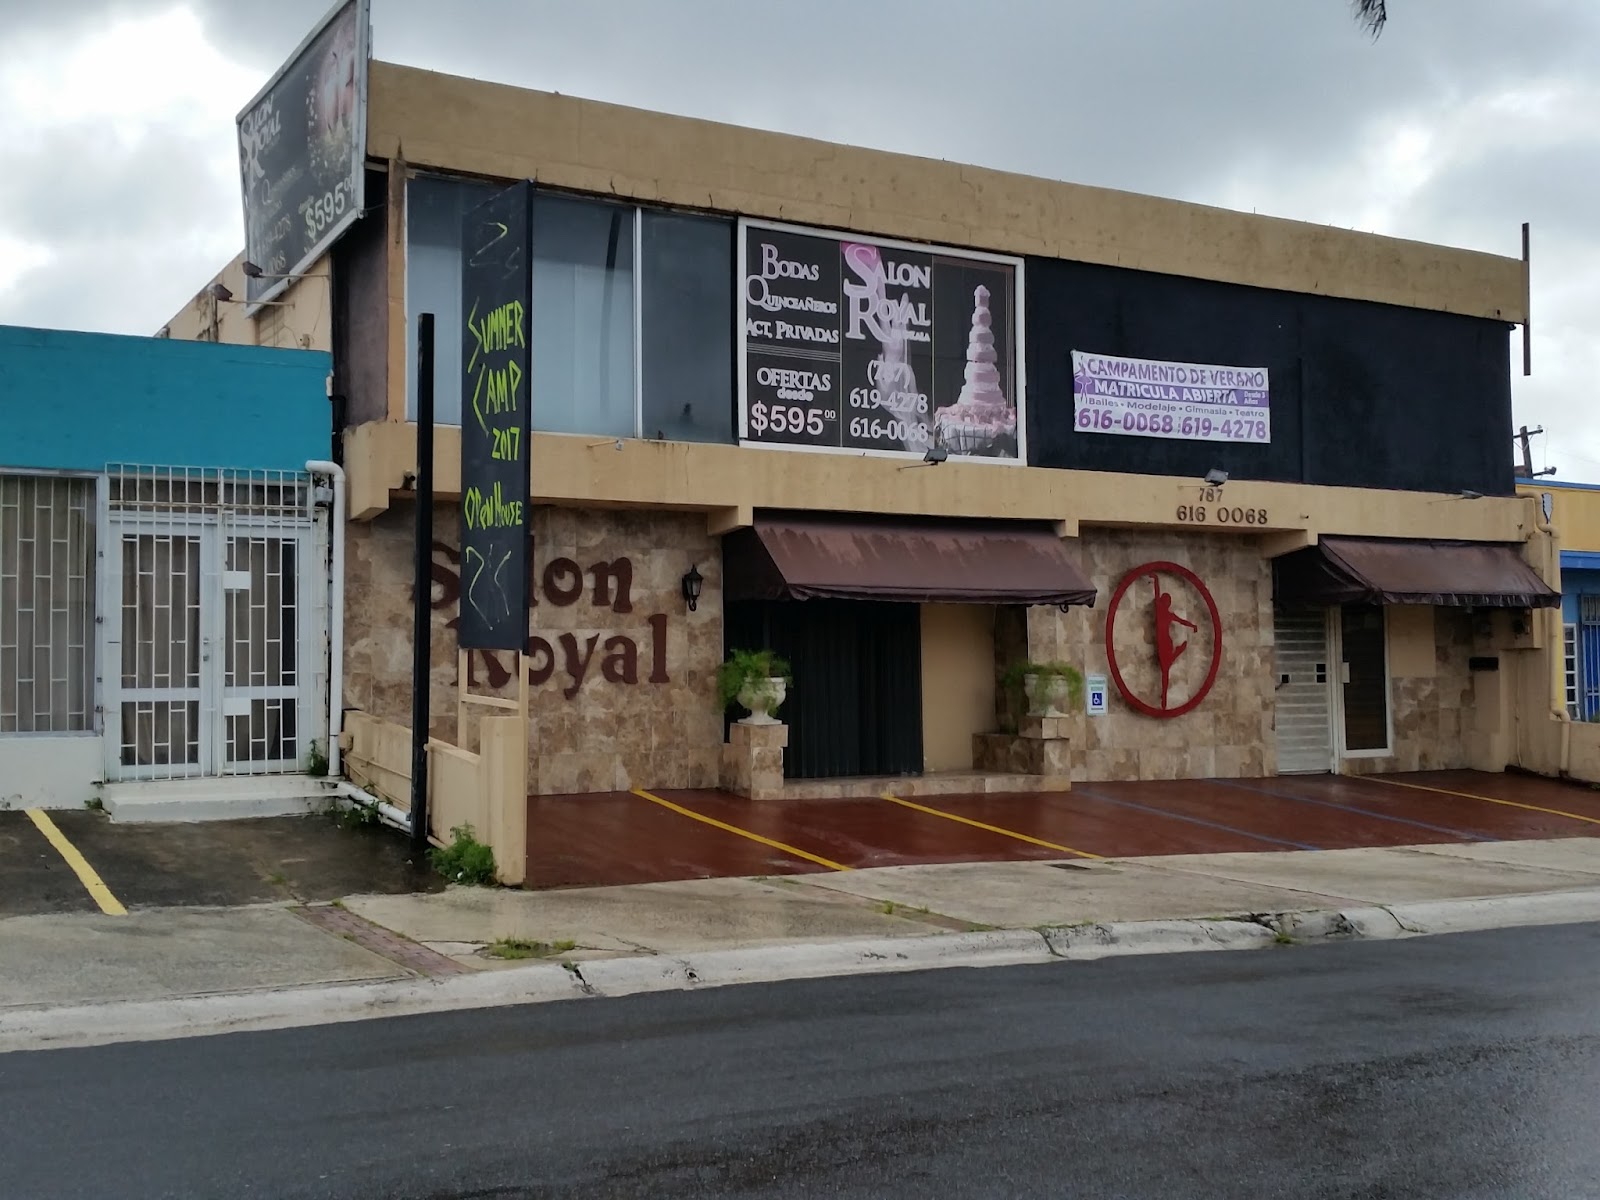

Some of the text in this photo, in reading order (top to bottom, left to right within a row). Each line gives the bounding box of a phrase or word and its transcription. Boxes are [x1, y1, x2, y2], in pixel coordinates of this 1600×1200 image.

[844, 243, 931, 298] SALON
[775, 321, 839, 343] PRIVADAS
[845, 294, 931, 343] ROYAL
[468, 298, 525, 374] SUMMER
[756, 367, 832, 392] OFERTAS
[867, 359, 911, 391] (77)
[1087, 359, 1265, 388] CAMPAMENTO DE VERANO
[472, 360, 522, 438] CAMP
[850, 387, 928, 414] 619-4278
[1094, 379, 1239, 405] MATRICULA ABIERTA
[1089, 397, 1266, 418] Bailes Modelaje Gimnasia Teatro
[850, 417, 928, 441] 616-0068
[1078, 407, 1174, 435] 616-0068
[1181, 416, 1267, 440] 619-4278
[491, 427, 521, 462] 2017
[1199, 487, 1224, 503] 787
[1176, 505, 1269, 525] 616 0068
